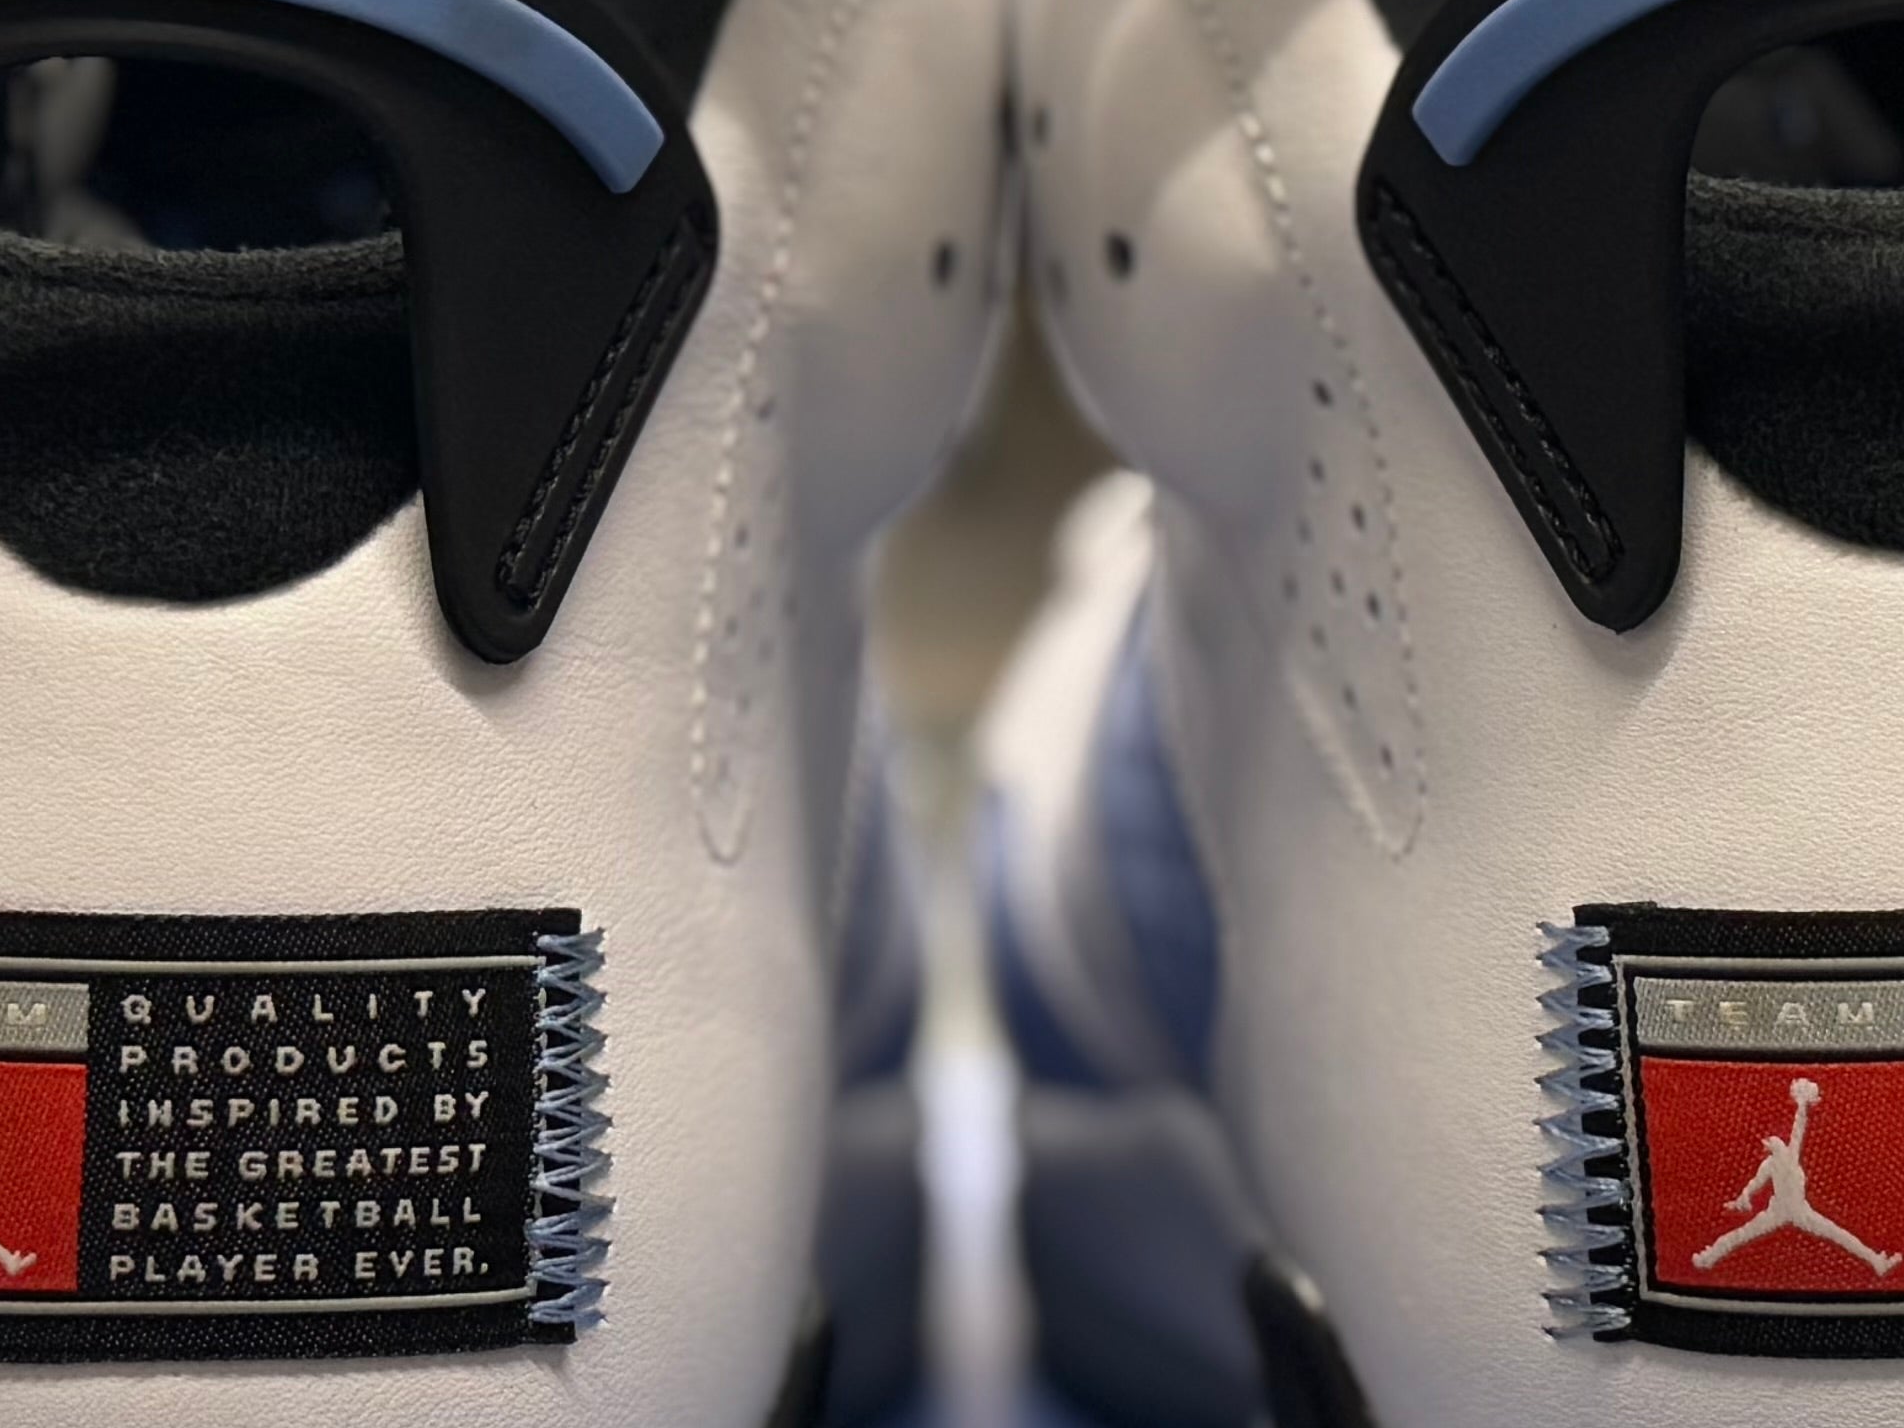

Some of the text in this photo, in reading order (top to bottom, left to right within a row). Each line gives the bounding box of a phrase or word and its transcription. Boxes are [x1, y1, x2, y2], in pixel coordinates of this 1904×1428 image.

[120, 987, 487, 1025] QUALITY
[1666, 999, 1876, 1026] TEAM
[120, 1039, 489, 1074] PRODUCTS
[117, 1090, 490, 1128] INSPIRED BY
[114, 1143, 487, 1181] THE GREATEST
[111, 1196, 482, 1232] BASKETBALL
[108, 1246, 489, 1283] PLAYER EVER.
